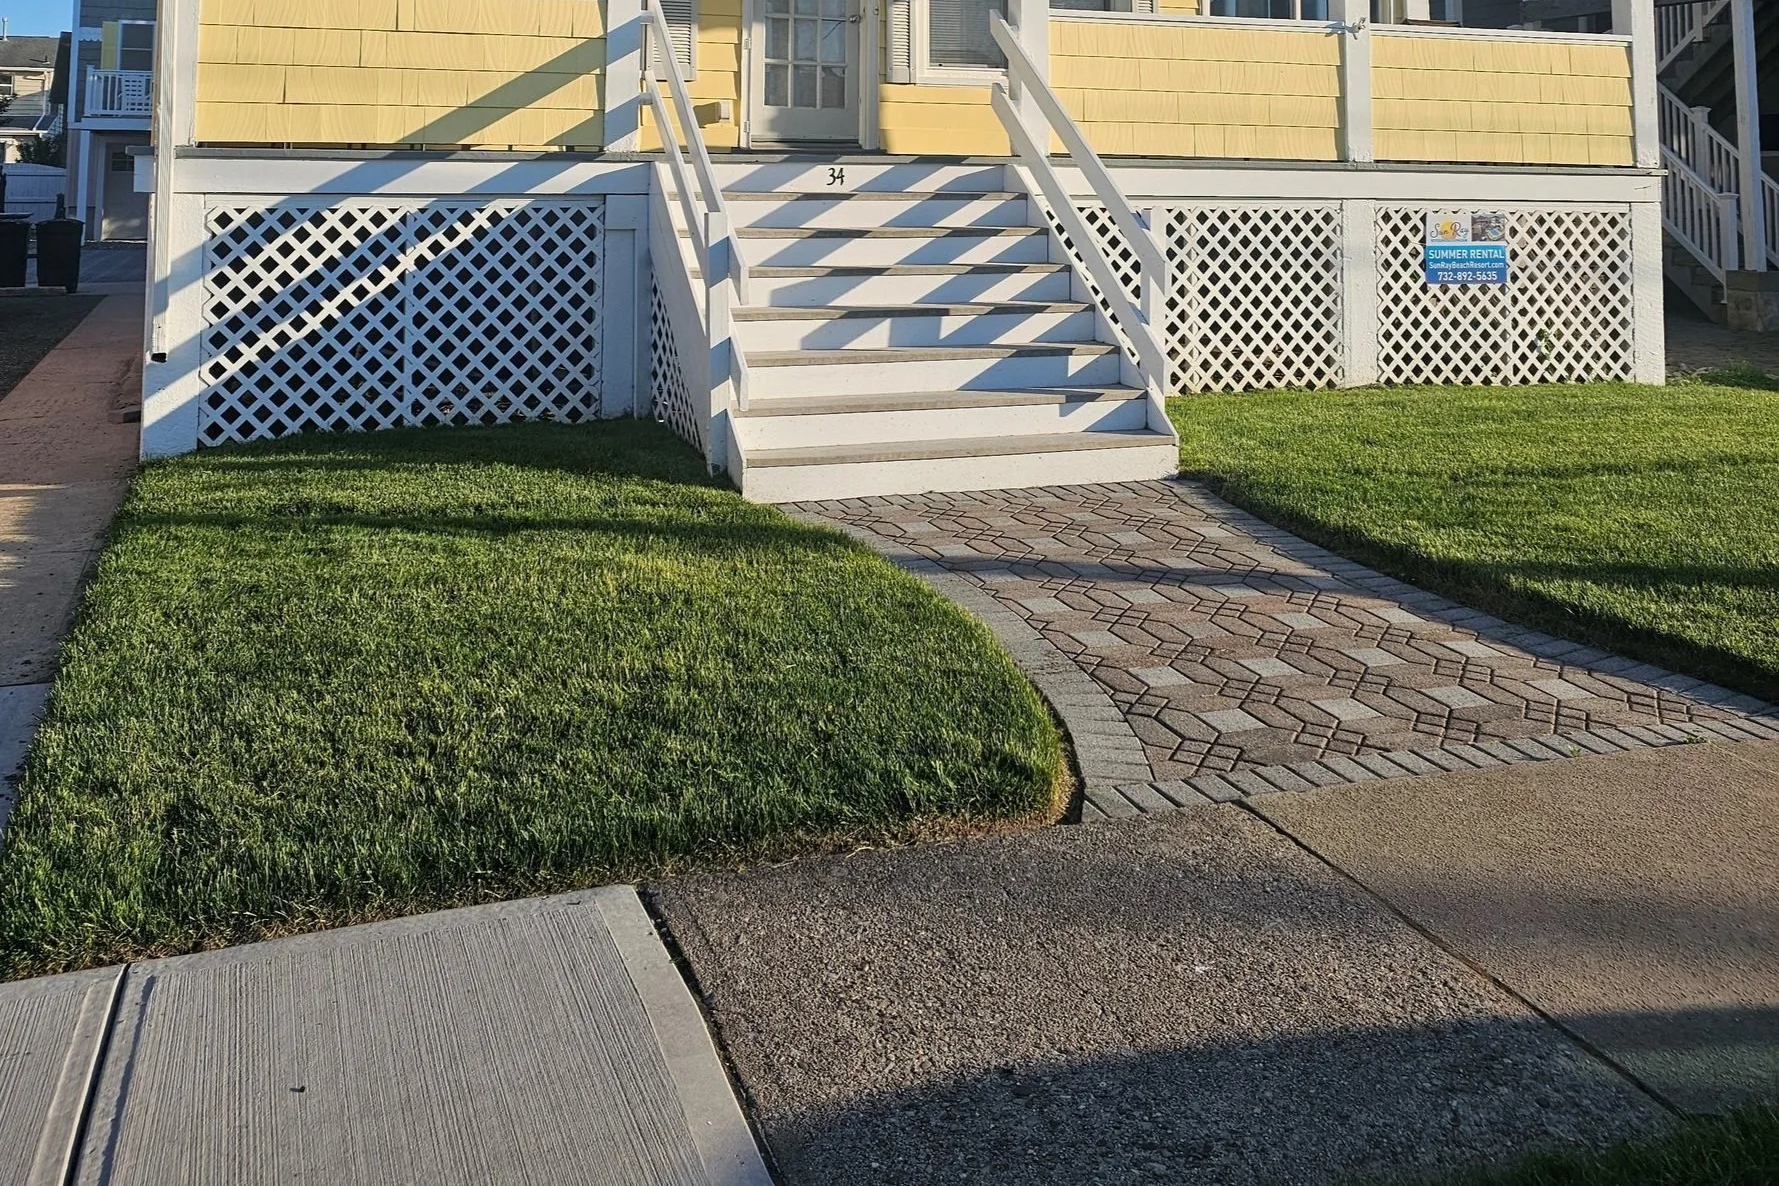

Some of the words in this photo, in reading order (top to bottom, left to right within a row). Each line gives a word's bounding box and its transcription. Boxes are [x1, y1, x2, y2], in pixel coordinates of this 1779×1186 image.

[826, 167, 845, 186] 34
[1450, 221, 1469, 239] Ray
[1428, 249, 1469, 259] SUMMER
[1469, 249, 1505, 259] RENTAL
[1428, 261, 1505, 270] SunRayBeachResort.com
[1437, 271, 1498, 281] 732-892-5635
